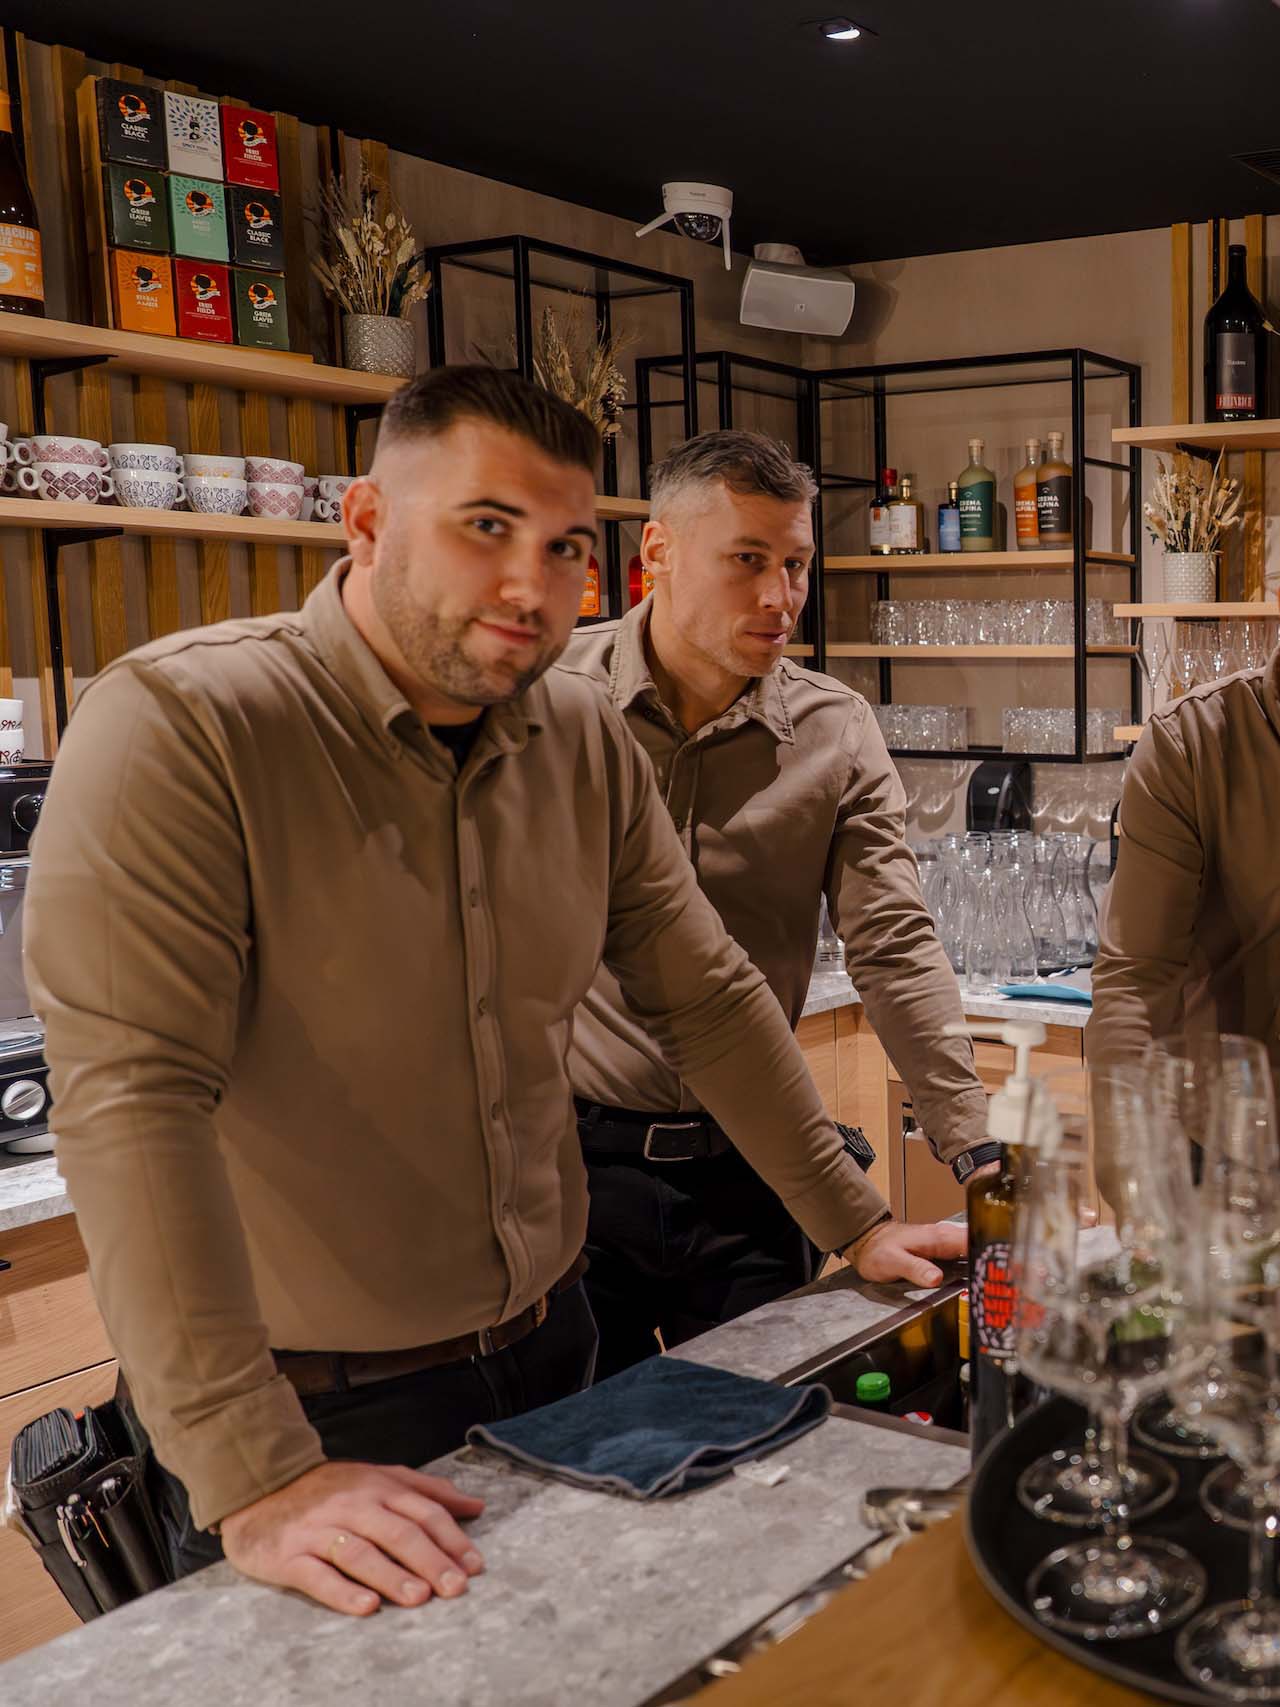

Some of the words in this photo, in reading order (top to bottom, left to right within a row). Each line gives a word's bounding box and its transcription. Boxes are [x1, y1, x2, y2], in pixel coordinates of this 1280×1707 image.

[121, 122, 149, 134] CLASSIC
[124, 129, 146, 139] BLACK
[246, 229, 272, 239] CLASSIC
